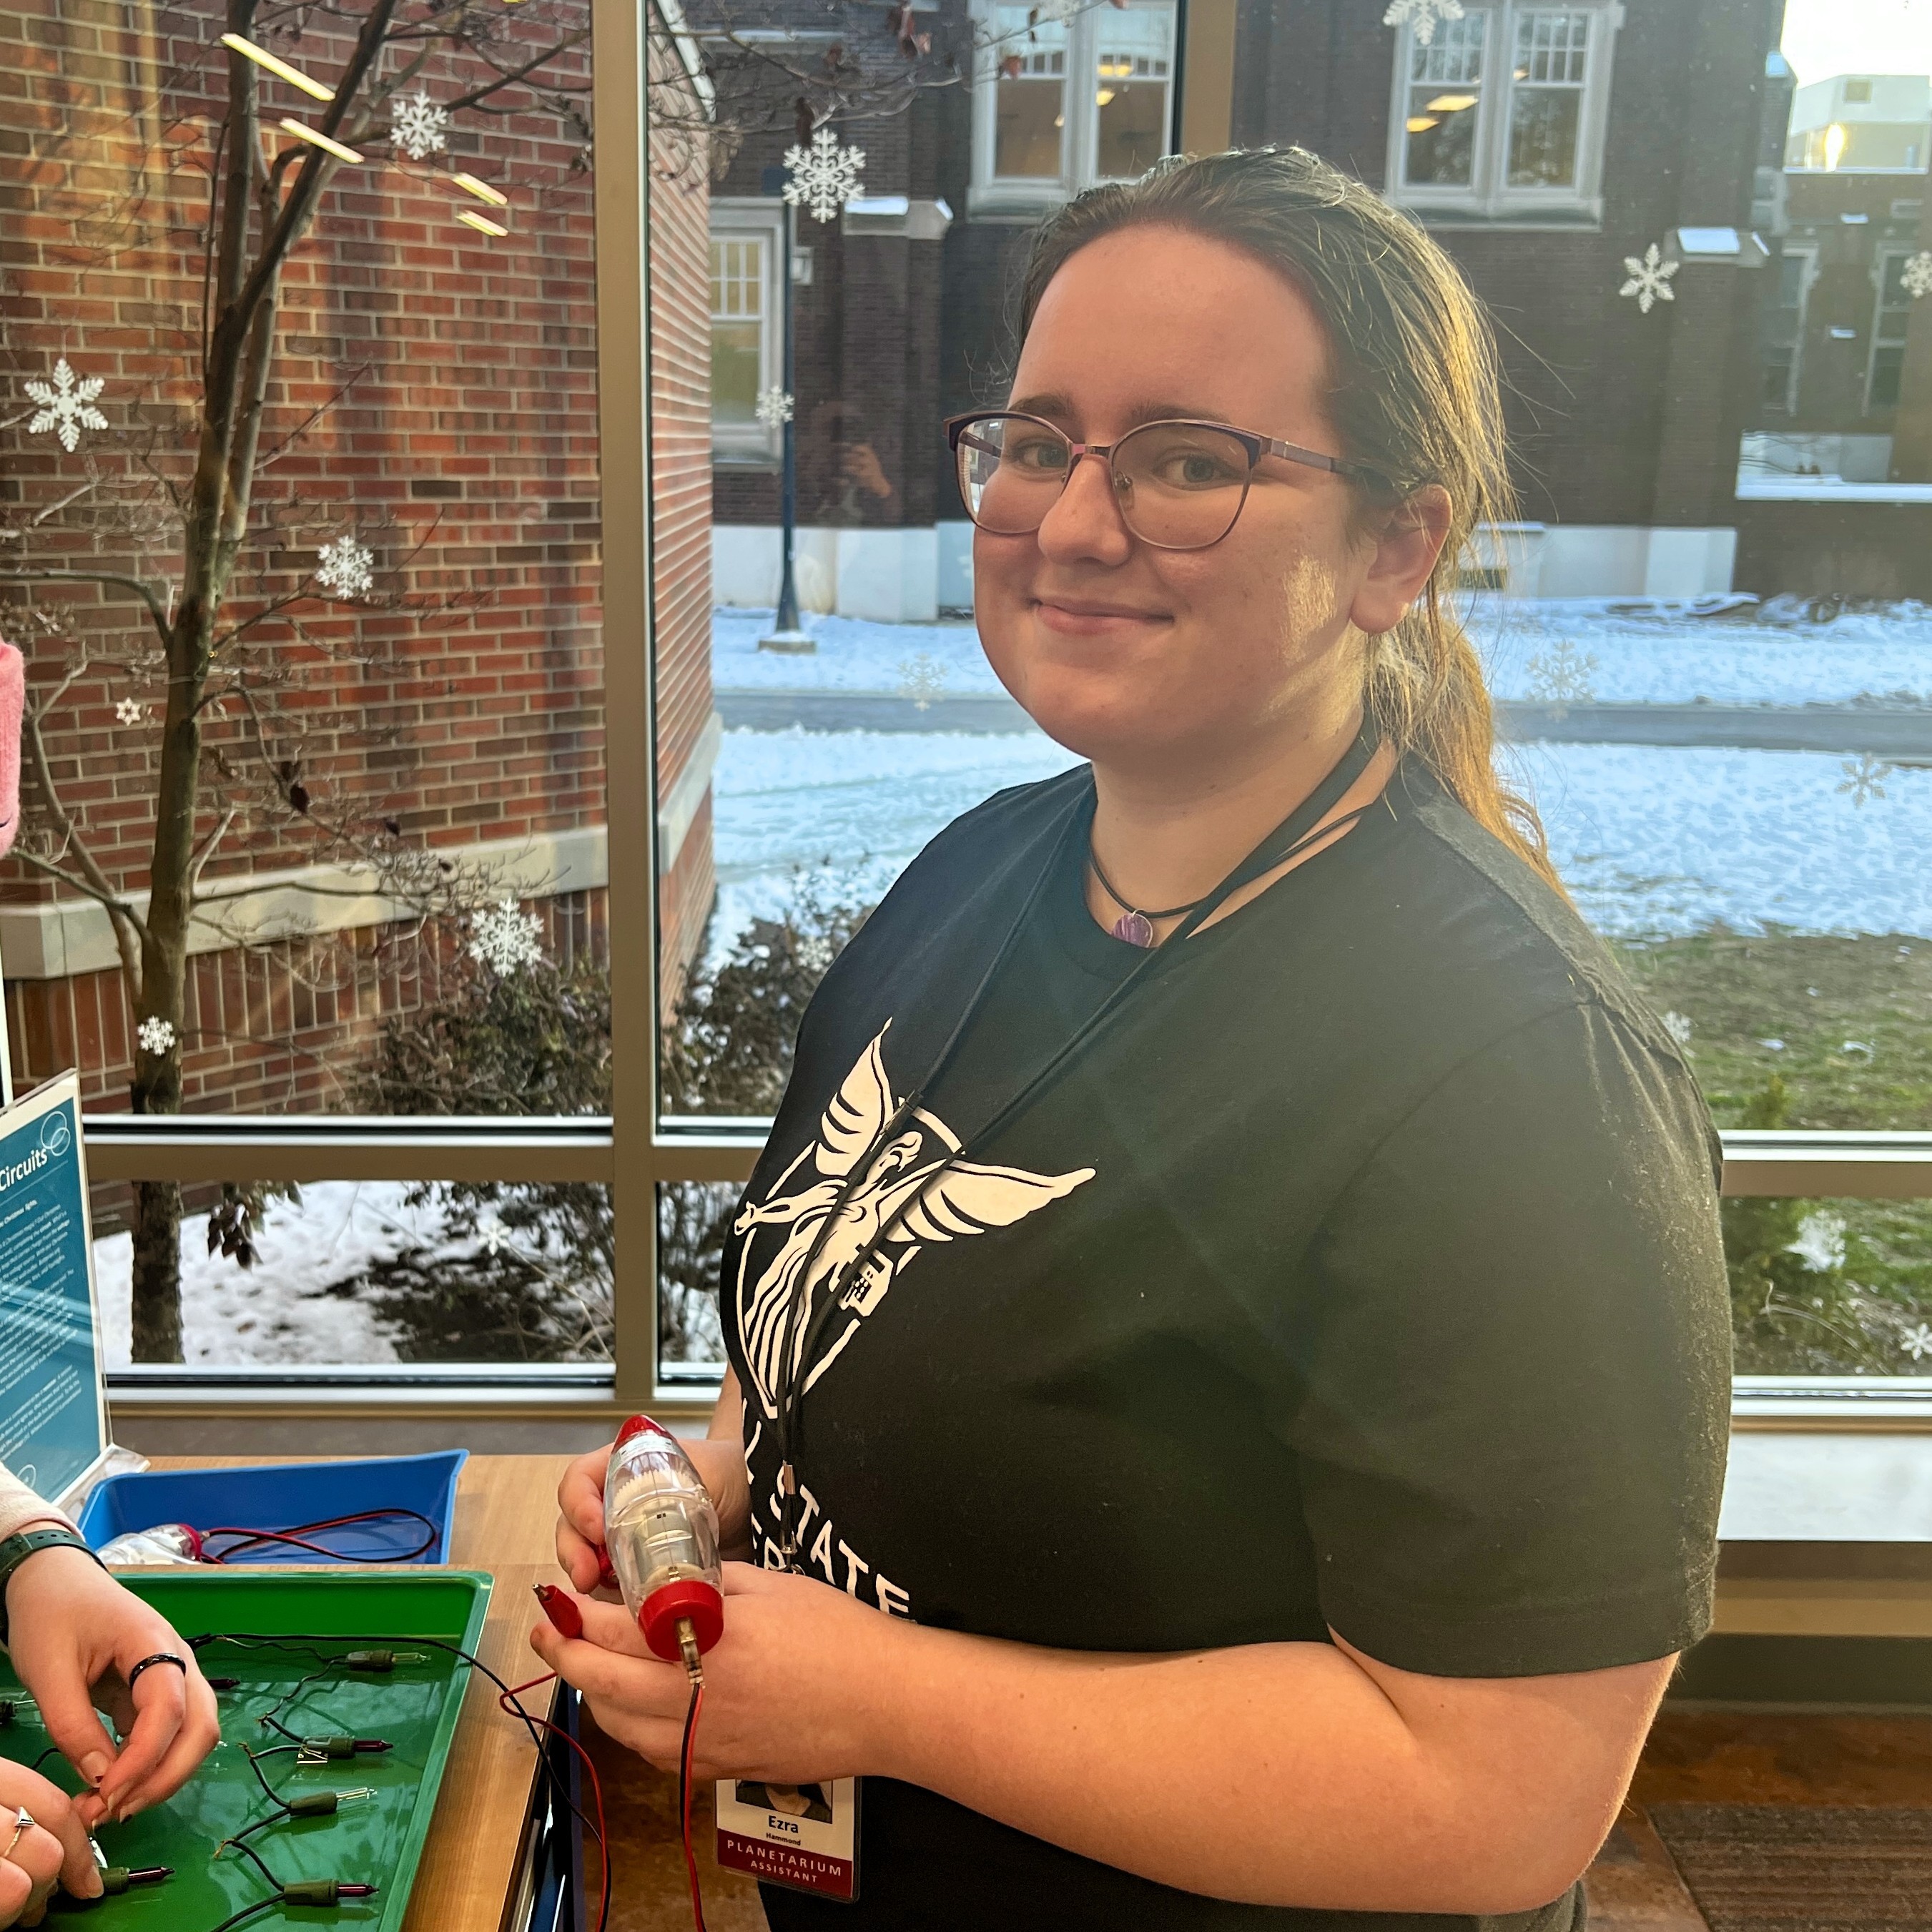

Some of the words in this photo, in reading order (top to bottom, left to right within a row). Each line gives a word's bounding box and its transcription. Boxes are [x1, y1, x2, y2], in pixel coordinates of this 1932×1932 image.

[0, 1148, 48, 1193] Circuits
[768, 1815, 799, 1833] Ezra
[766, 1832, 802, 1846] Hammond
[727, 1839, 841, 1876] PLANETARIUM
[750, 1860, 817, 1883] ASSISTANT
